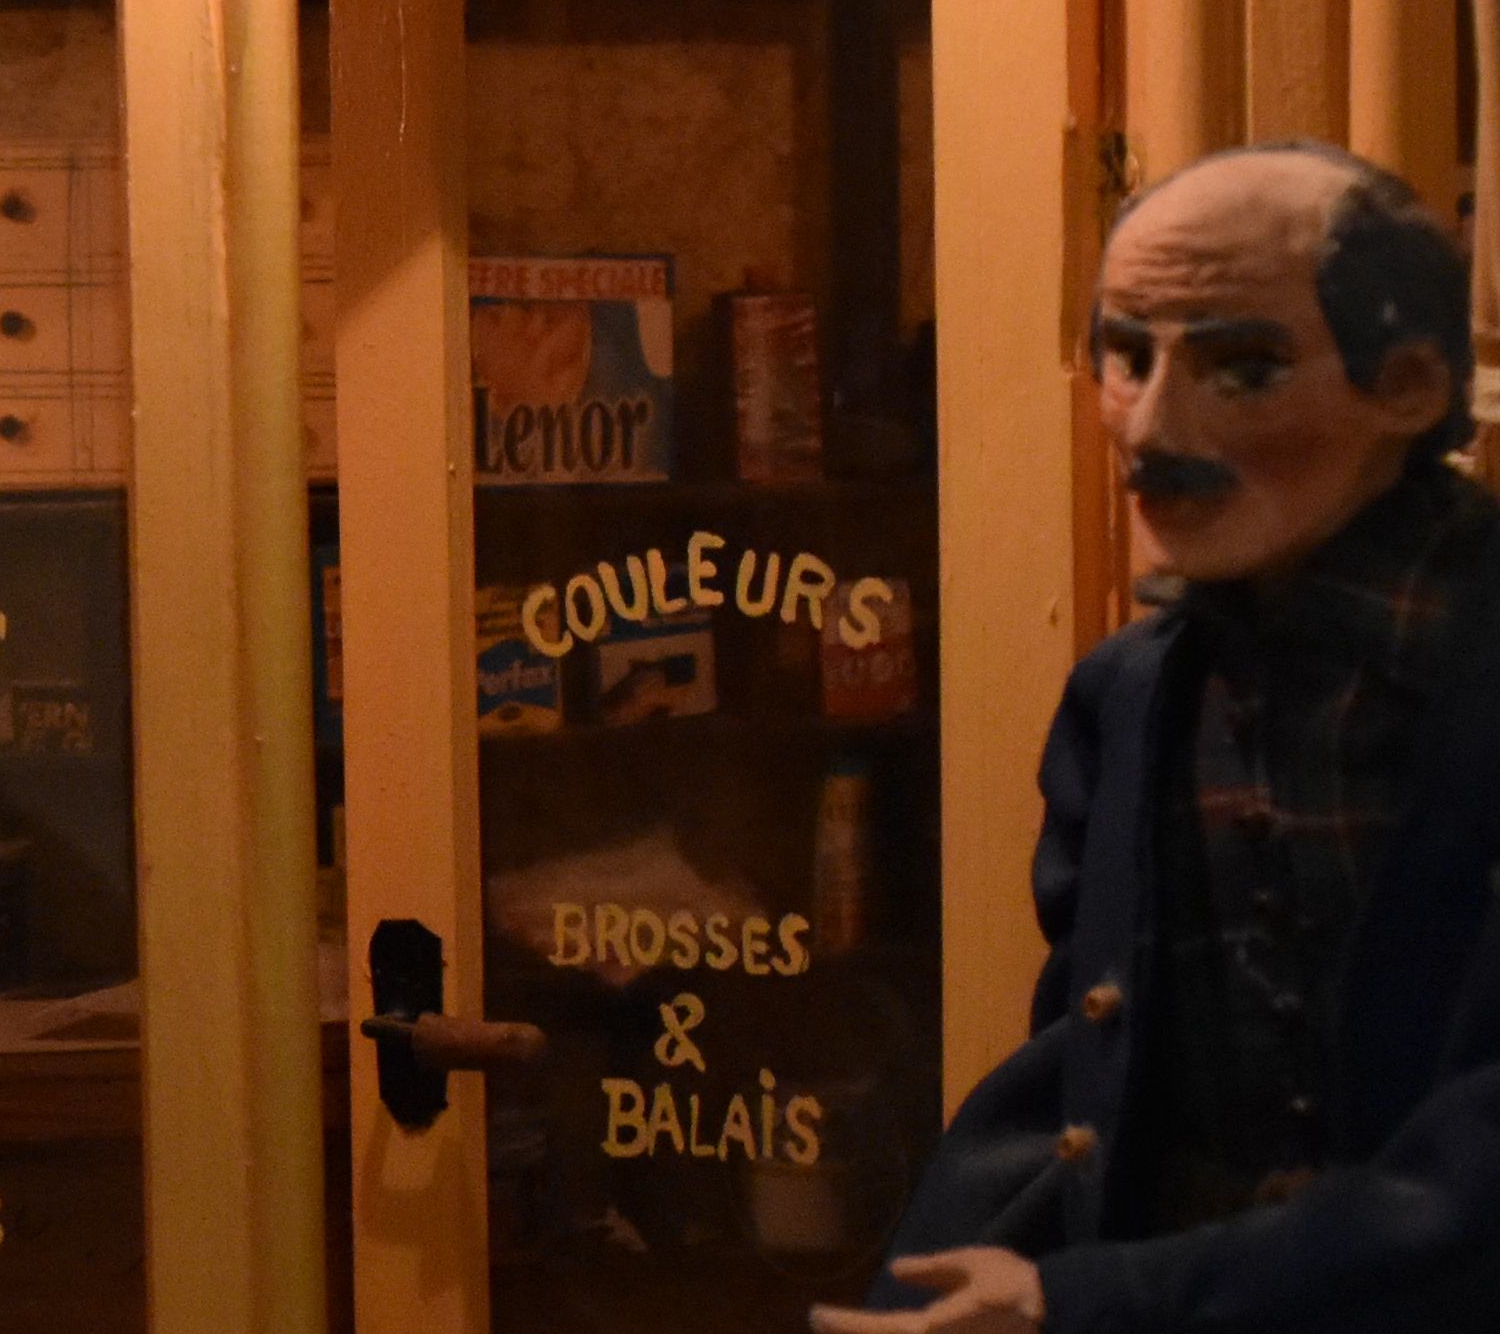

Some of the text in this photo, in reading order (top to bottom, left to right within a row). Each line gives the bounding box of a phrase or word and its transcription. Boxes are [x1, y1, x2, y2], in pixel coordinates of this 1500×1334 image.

[473, 385, 650, 474] Lenor
[521, 530, 893, 658] COULEURS
[547, 901, 811, 977] BROSSES
[652, 991, 707, 1073] &
